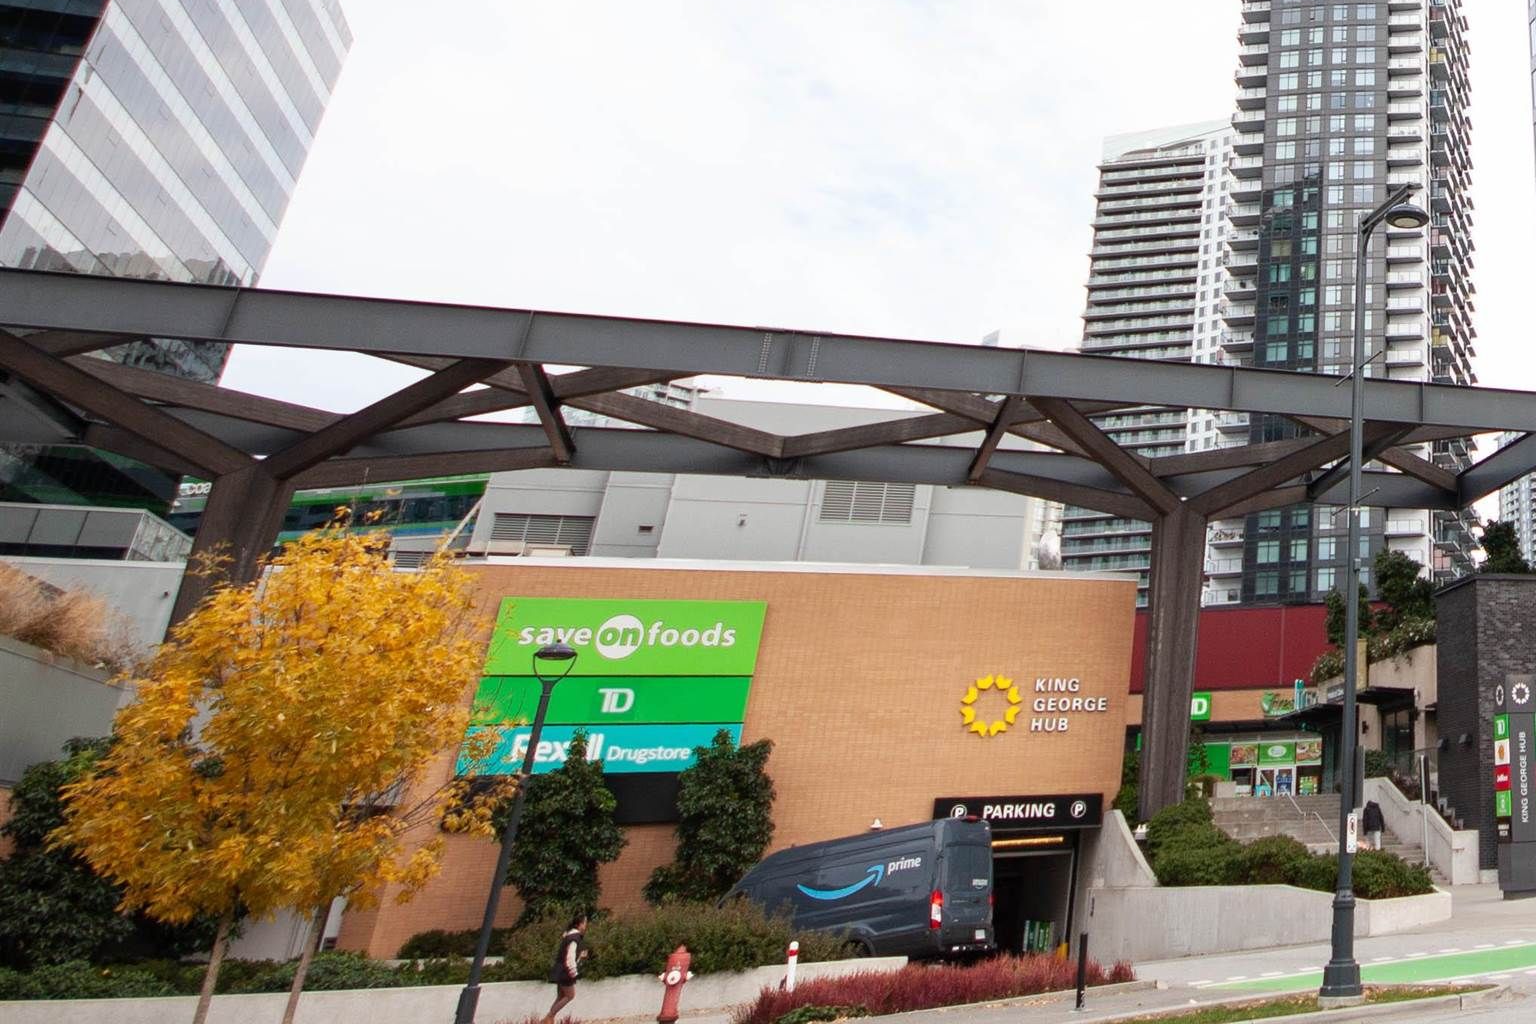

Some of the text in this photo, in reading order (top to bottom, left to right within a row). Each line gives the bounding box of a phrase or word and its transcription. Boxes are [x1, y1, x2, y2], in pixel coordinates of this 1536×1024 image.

[518, 621, 737, 647] save on foods
[1034, 677, 1081, 693] KING
[598, 687, 636, 714] TD
[1033, 696, 1108, 713] GEORGE
[1190, 697, 1208, 716] D
[1030, 717, 1070, 733] HUB
[510, 733, 692, 764] Rexll Drugstore
[1518, 732, 1529, 823] KING GEORGE HUB
[983, 803, 1056, 820] PARKING
[887, 856, 923, 876] prime
